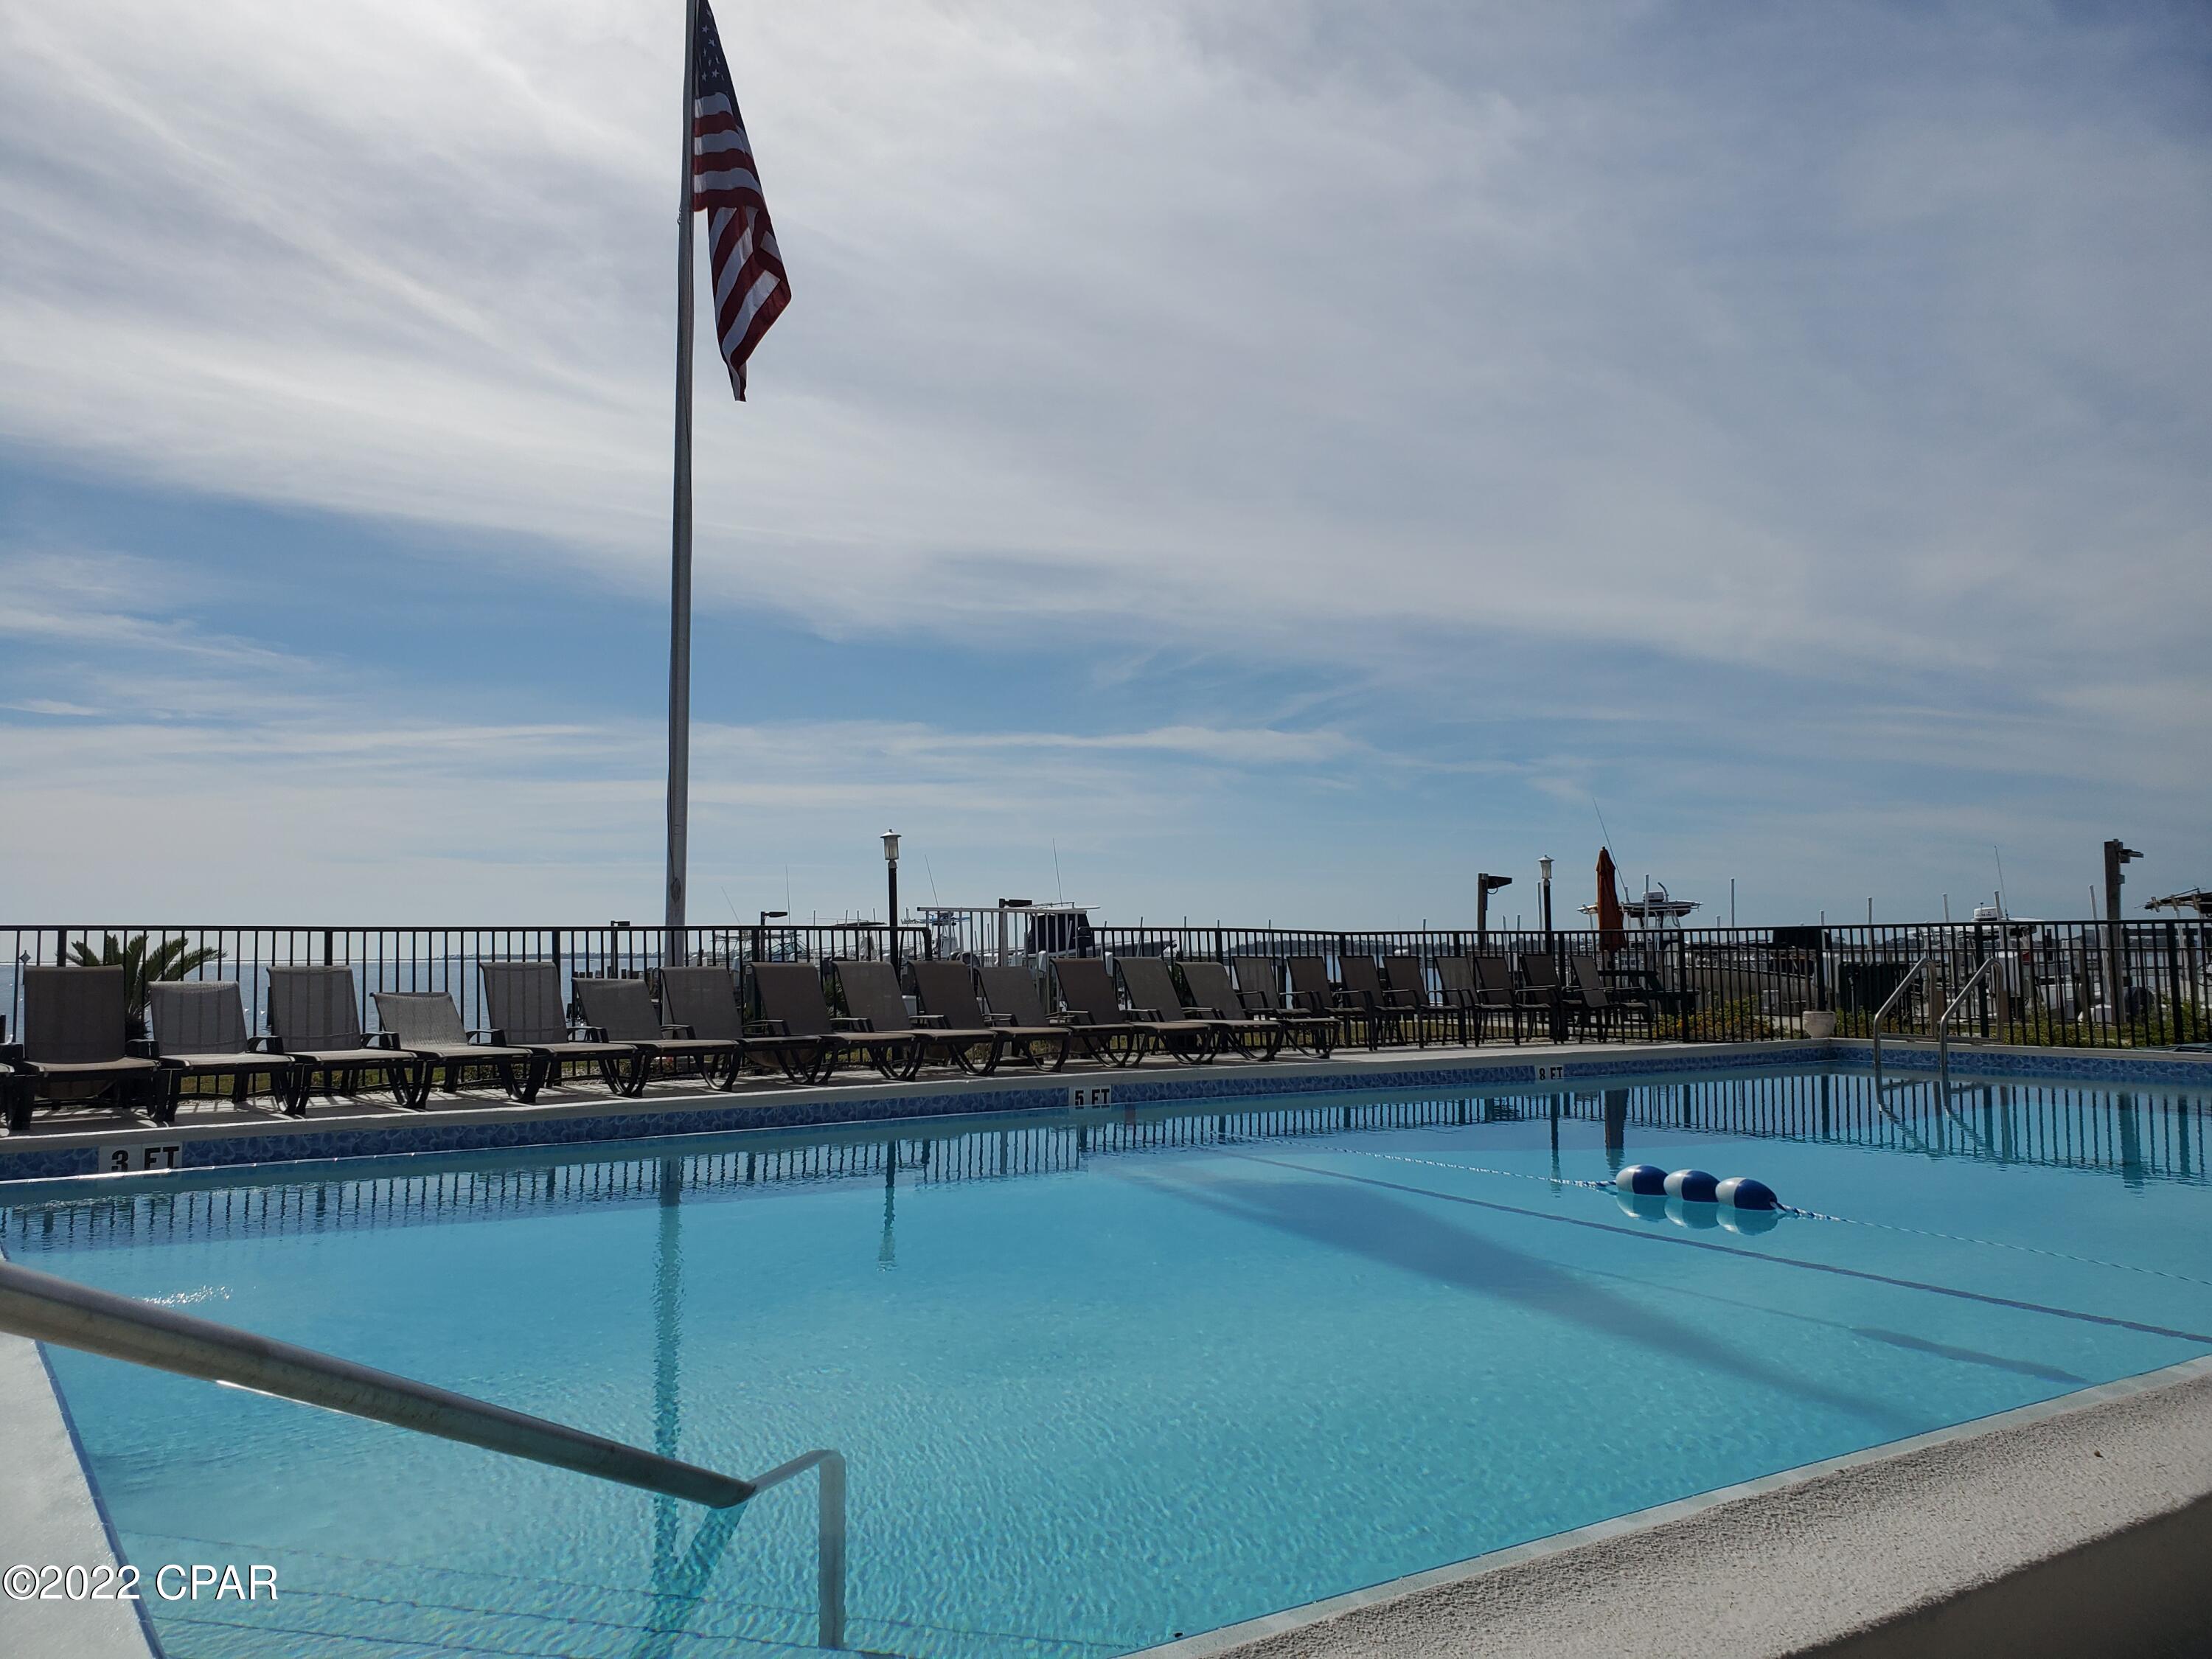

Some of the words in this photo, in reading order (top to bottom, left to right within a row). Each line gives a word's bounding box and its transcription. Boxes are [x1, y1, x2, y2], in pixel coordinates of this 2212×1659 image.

[1075, 1090, 1084, 1106] 5
[1091, 1088, 1110, 1105] FT
[111, 1150, 128, 1172] 3
[144, 1146, 179, 1170] FT
